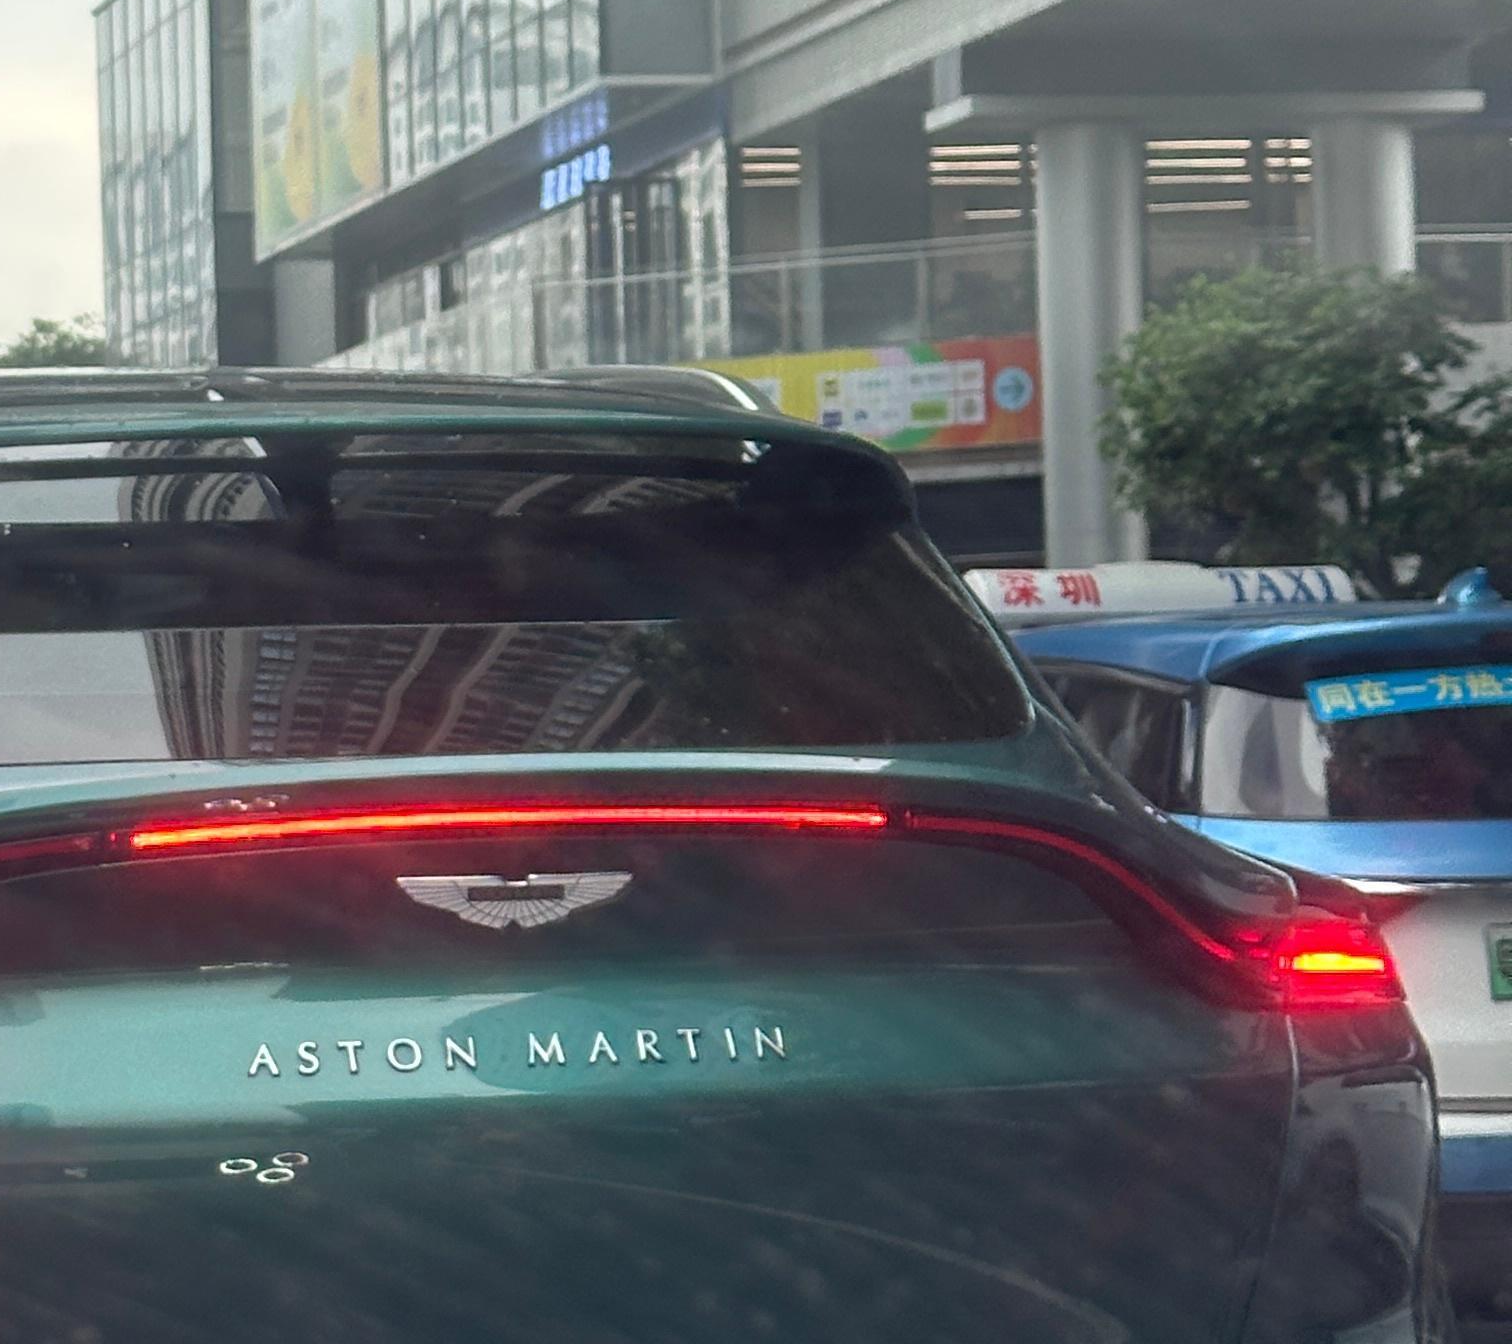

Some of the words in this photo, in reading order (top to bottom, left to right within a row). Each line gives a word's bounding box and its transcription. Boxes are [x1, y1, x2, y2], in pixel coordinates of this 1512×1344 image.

[998, 569, 1102, 609] 深圳
[1219, 566, 1338, 604] TAXI
[248, 1034, 478, 1077] ASTON
[527, 1024, 788, 1067] MARTIN
